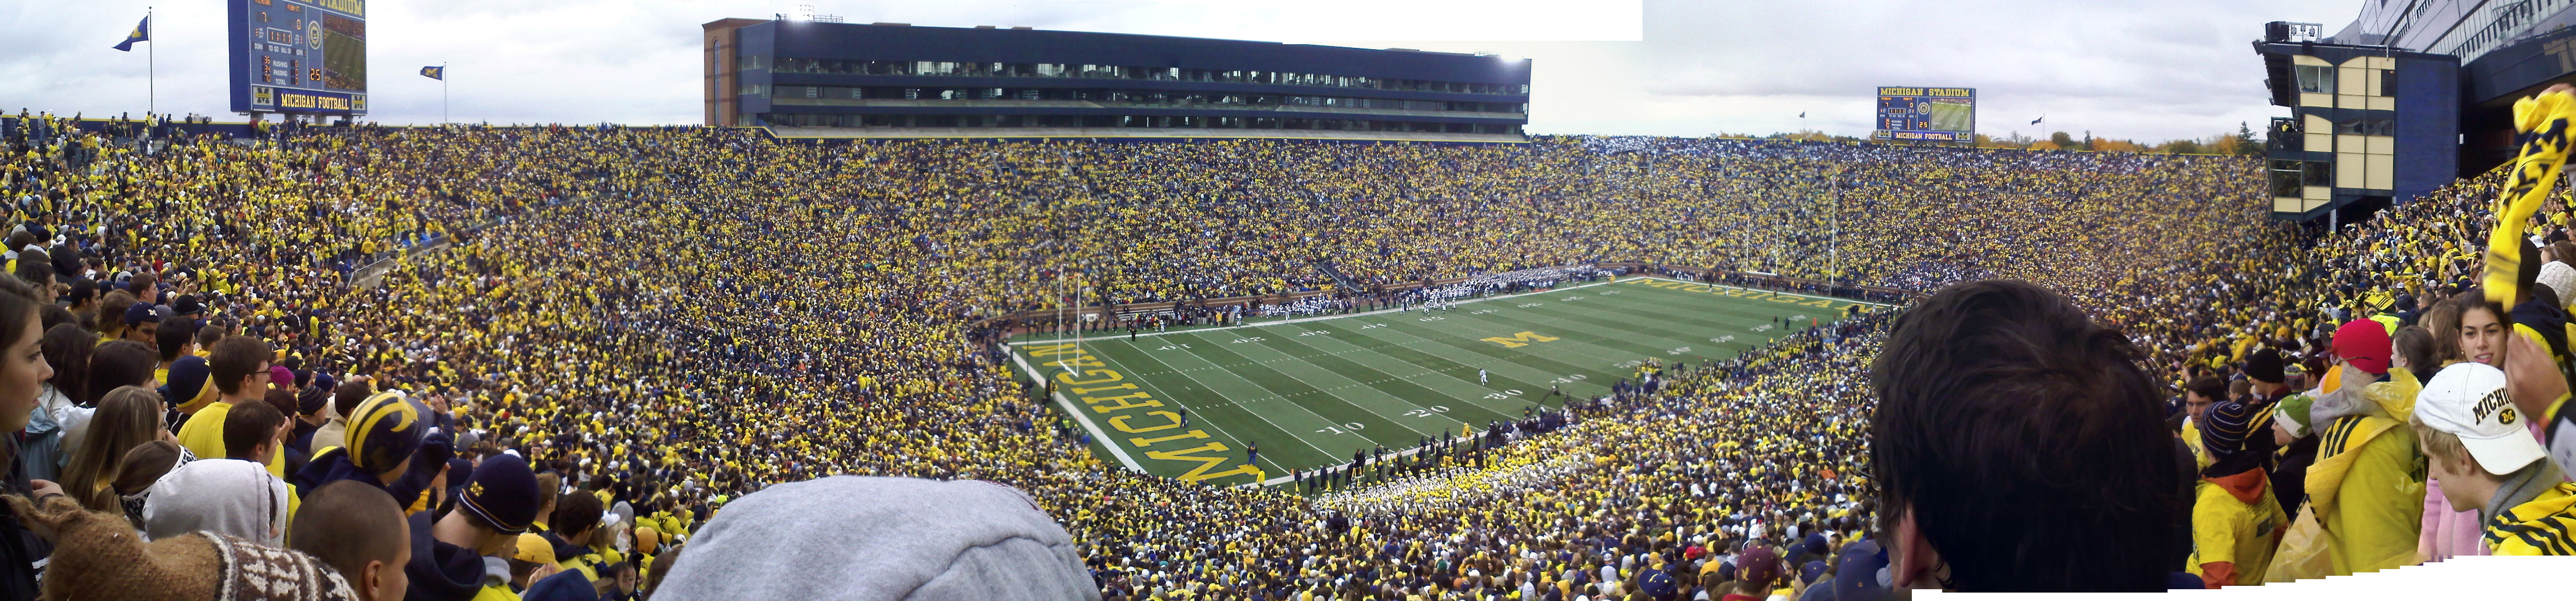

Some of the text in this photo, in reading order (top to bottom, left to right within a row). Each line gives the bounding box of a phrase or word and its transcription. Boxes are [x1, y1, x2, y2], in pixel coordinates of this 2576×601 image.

[262, 12, 267, 22] 7
[297, 19, 301, 30] 0
[255, 28, 258, 37] 3
[265, 56, 270, 64] 36
[265, 74, 271, 83] 70
[310, 68, 321, 81] 25
[425, 68, 438, 78] M
[1929, 88, 1969, 97] STADIUM
[281, 93, 349, 110] MICHIGAN FOOTBALL
[1480, 331, 1560, 348] M
[1558, 374, 1587, 383] 40
[1487, 389, 1523, 399] 30
[1408, 405, 1450, 418] 20
[2472, 387, 2512, 426] MICHI
[1021, 343, 1261, 485] MICHIGAN
[2501, 410, 2515, 423] M
[1324, 422, 1365, 434] 10
